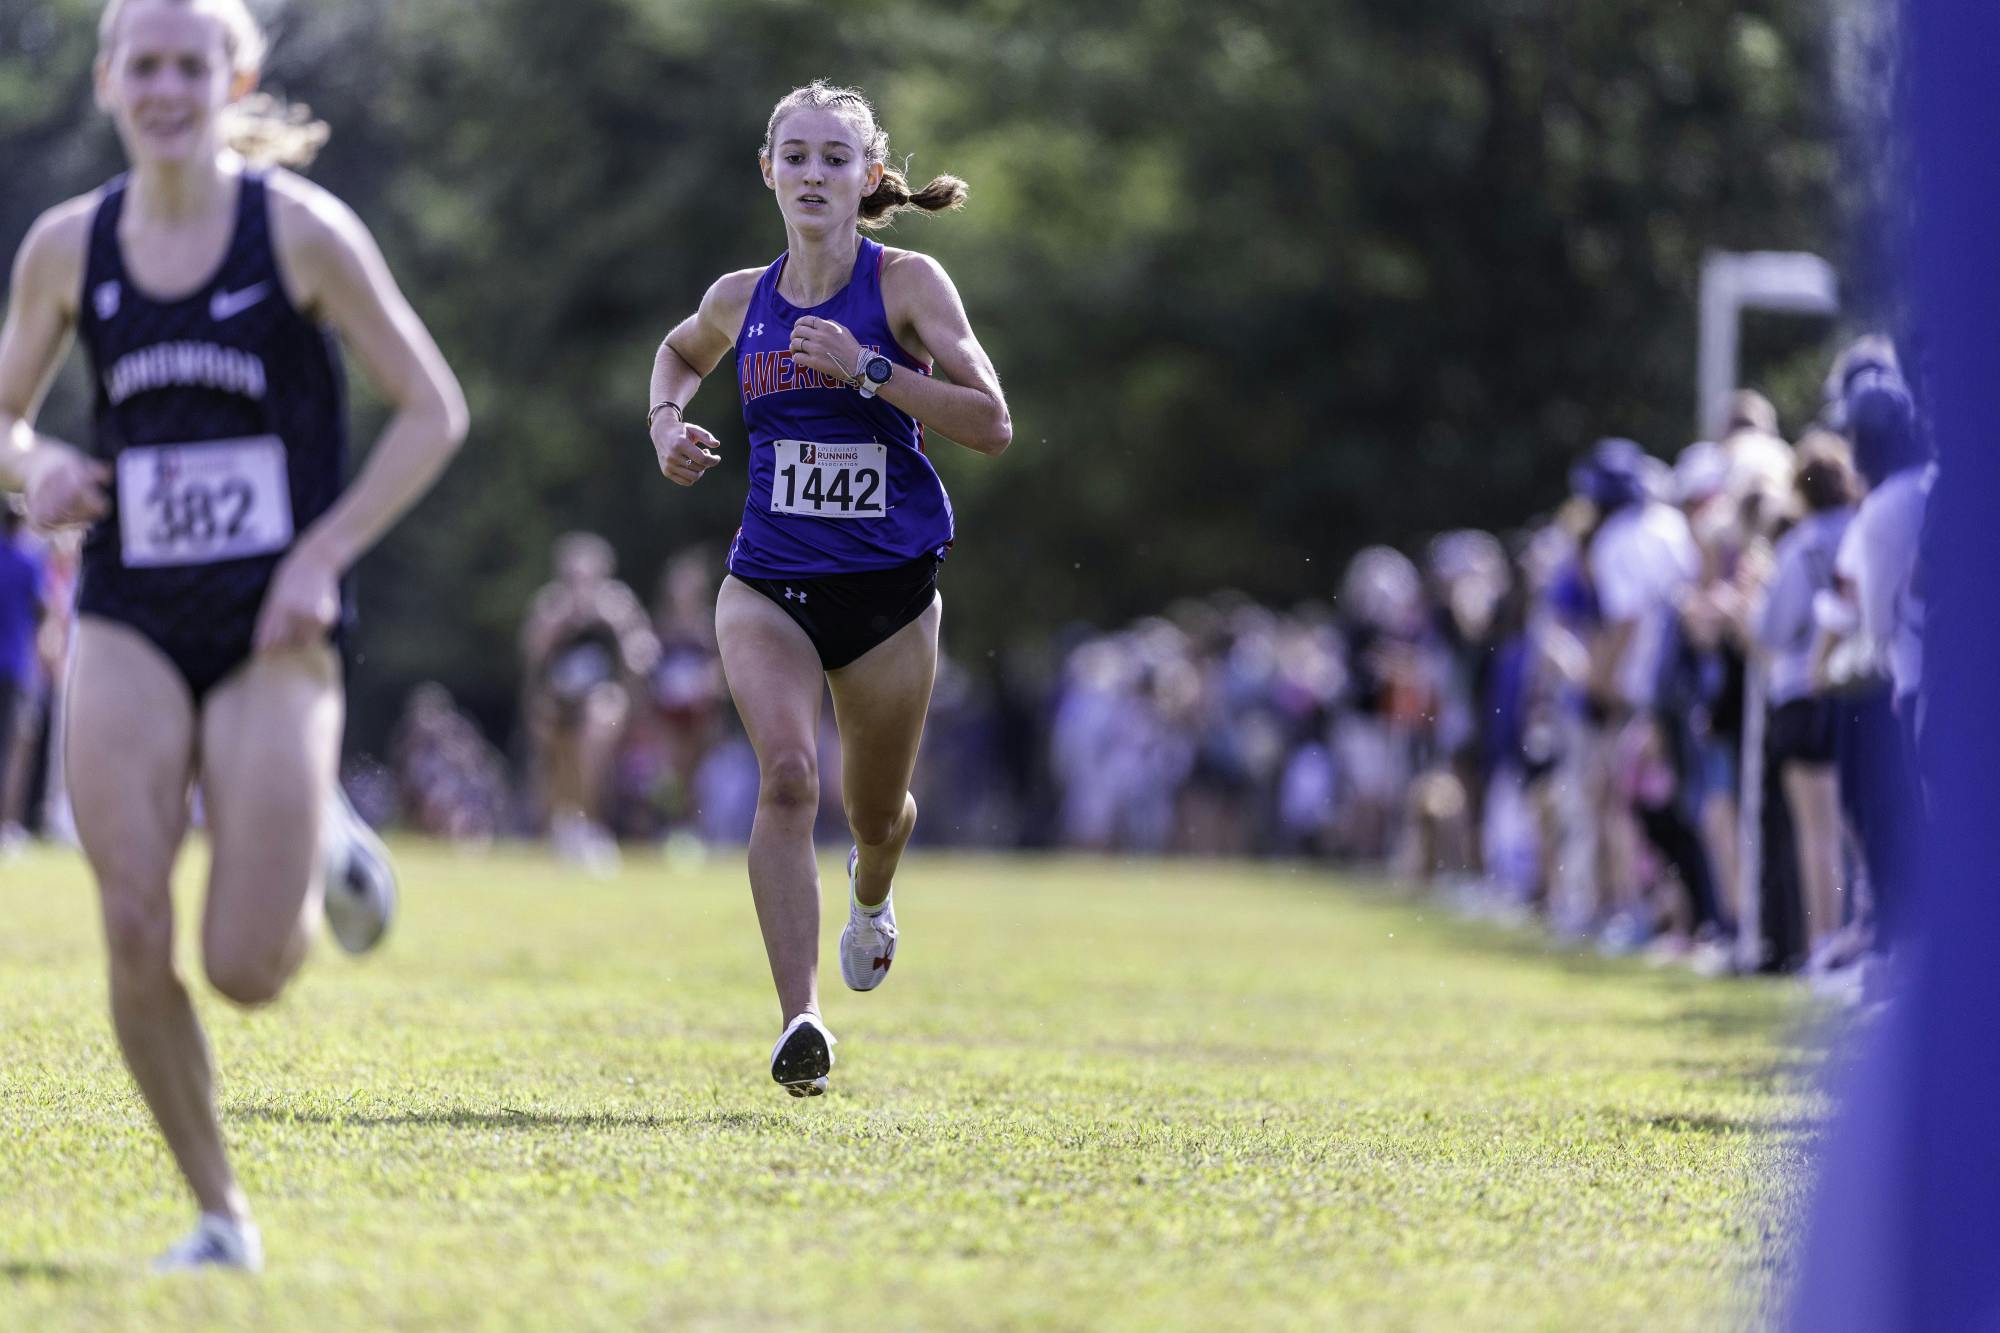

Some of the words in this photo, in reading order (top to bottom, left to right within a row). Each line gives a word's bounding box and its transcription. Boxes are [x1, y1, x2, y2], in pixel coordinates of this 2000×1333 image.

[742, 344, 880, 405] AMER
[817, 452, 858, 460] RUNNING
[147, 477, 256, 545] 382
[781, 464, 880, 511] 1442
